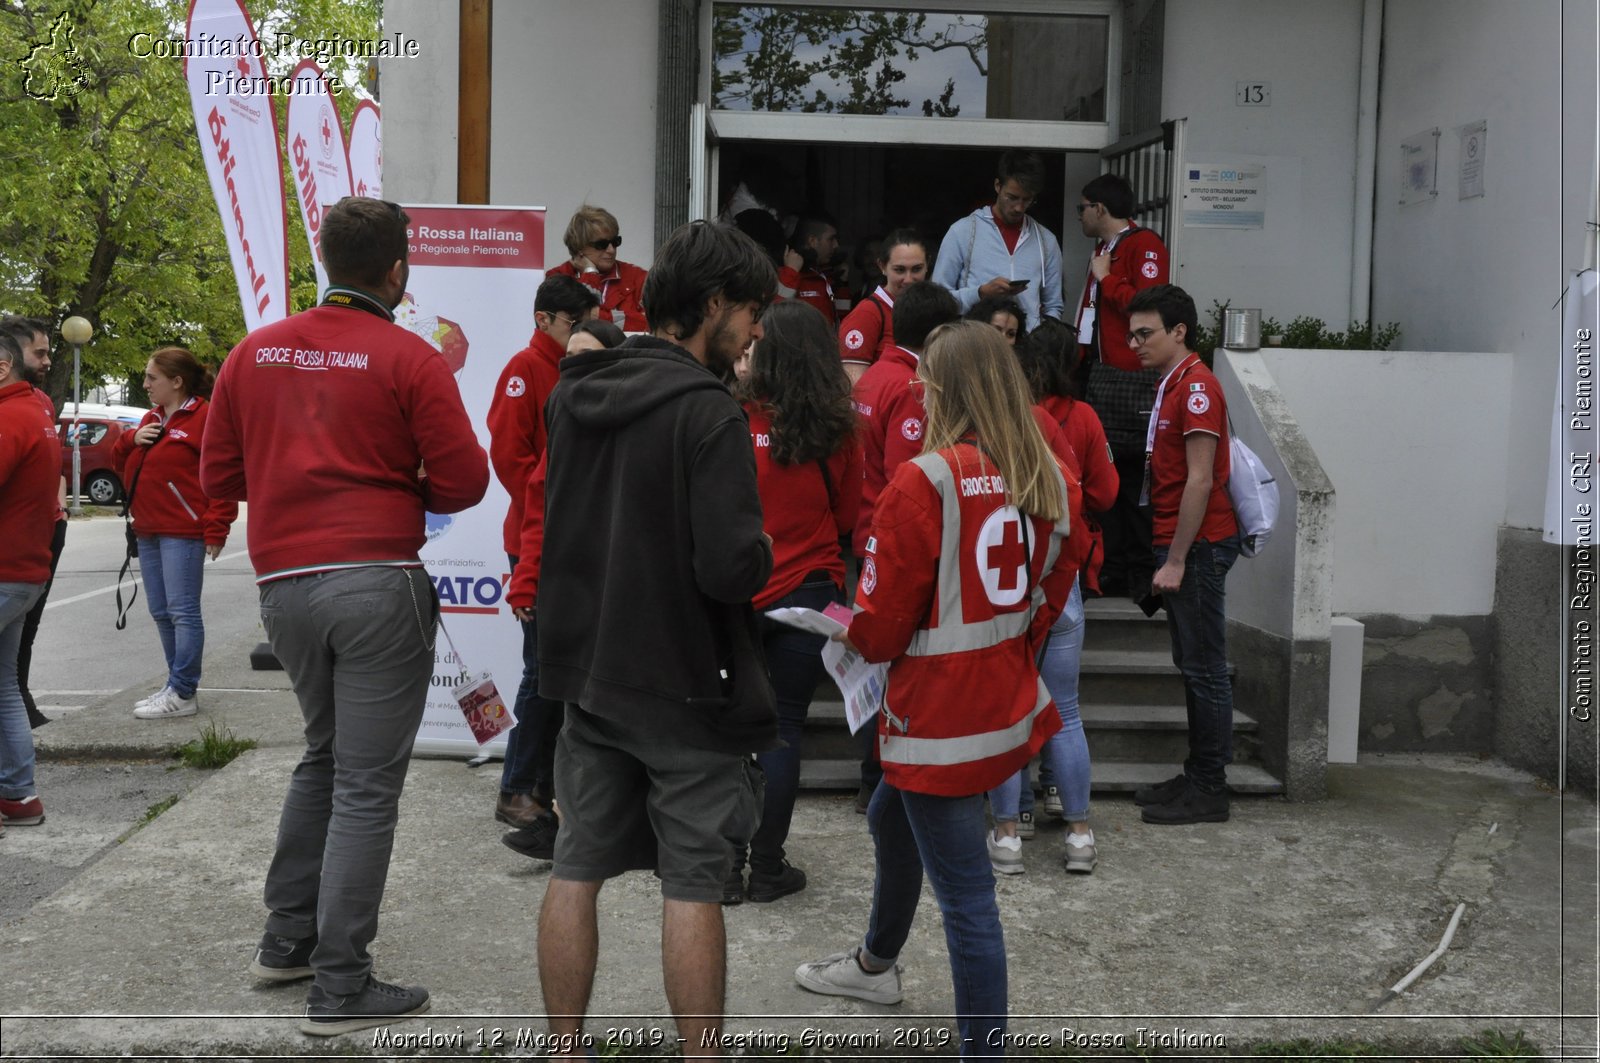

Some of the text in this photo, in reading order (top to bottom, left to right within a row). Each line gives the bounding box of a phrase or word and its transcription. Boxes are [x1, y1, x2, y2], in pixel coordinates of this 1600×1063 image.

[1244, 85, 1264, 103] 13
[1209, 187, 1234, 195] ISTRUZIONE
[418, 226, 466, 240] Rossa
[470, 227, 524, 242] Italiana
[420, 243, 470, 256] Regionale
[472, 245, 520, 256] Piemonte
[256, 347, 369, 370] CROCE ROSSA ITALIANA
[756, 433, 771, 447] RO
[961, 475, 1004, 497] CROCE RO
[437, 558, 486, 567] all'iniziativa:
